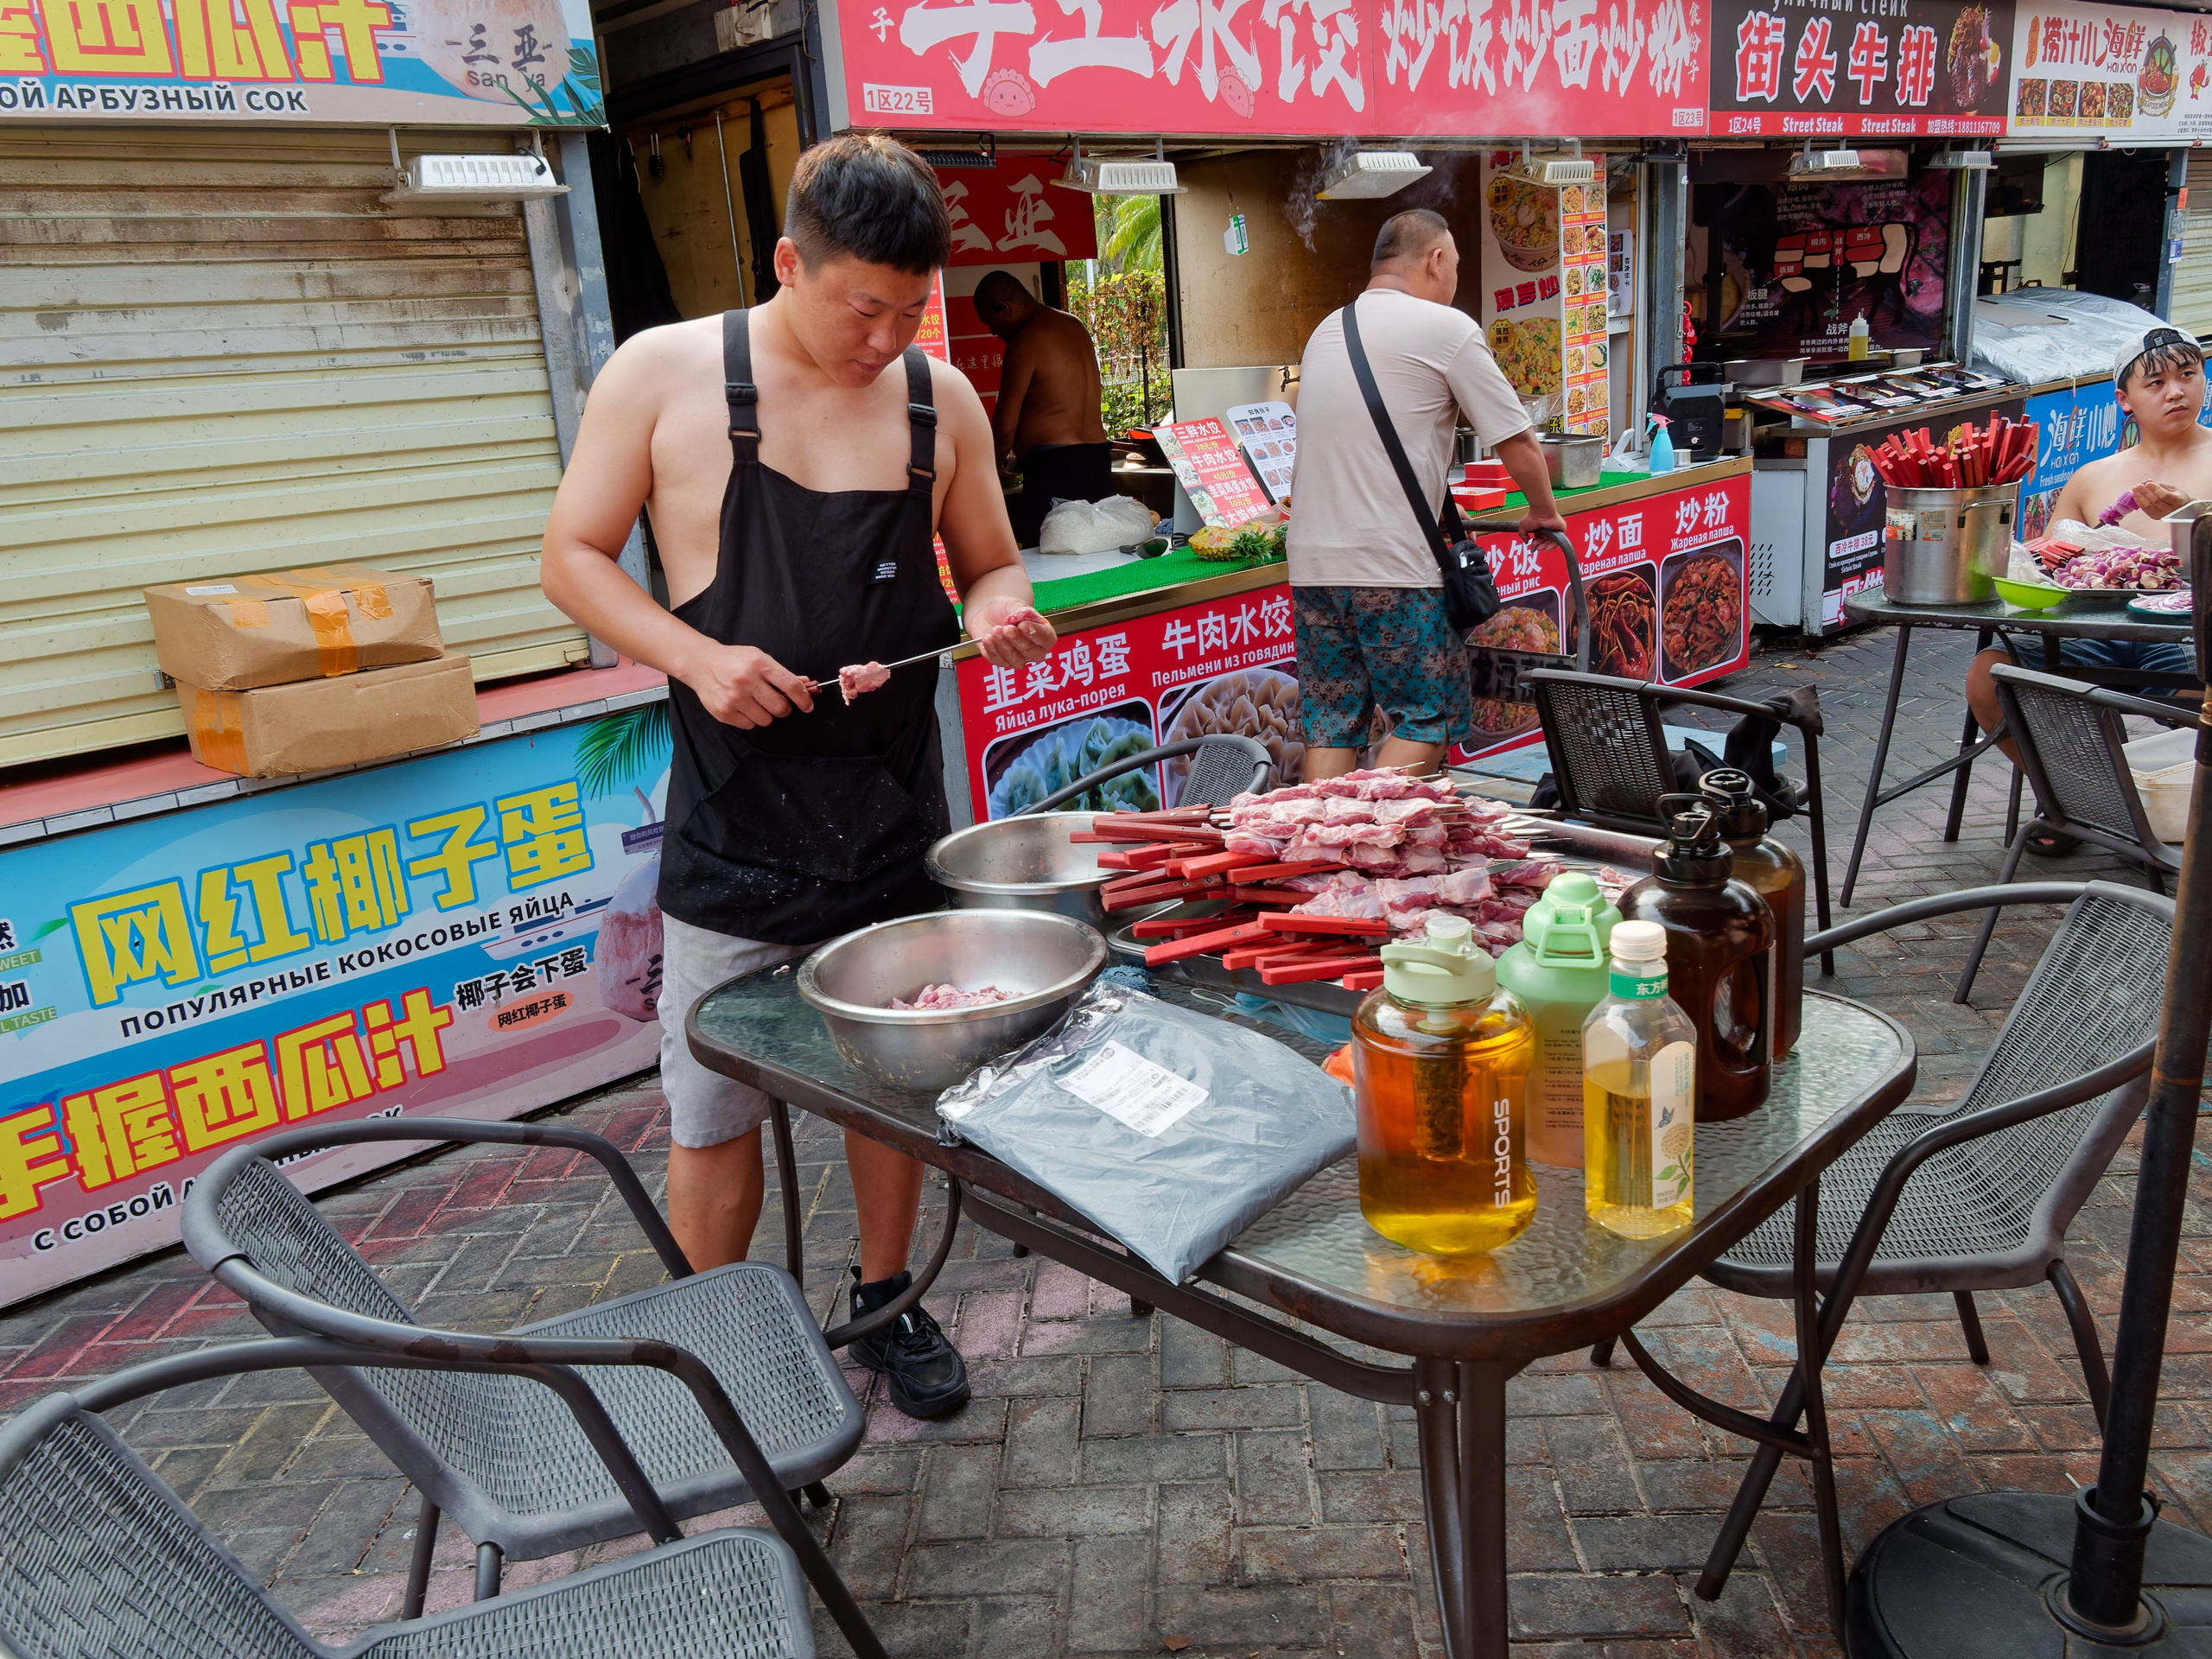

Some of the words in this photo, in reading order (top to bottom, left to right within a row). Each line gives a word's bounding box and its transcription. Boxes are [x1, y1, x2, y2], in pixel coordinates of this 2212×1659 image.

[461, 23, 546, 68] 三亚
[2041, 16, 2147, 68] 捞汁小海鲜
[2190, 19, 2212, 57] 椒
[1736, 10, 1937, 105] 街头牛排
[467, 71, 509, 87] san
[57, 83, 237, 111] АРБУЗНЫЙ
[246, 91, 308, 112] СОК
[866, 90, 932, 113] 1区22号
[1674, 111, 1703, 125] 1区23号
[1728, 118, 1761, 133] 1区24号
[1783, 117, 1814, 133] Street
[1815, 118, 1843, 133] Steak
[1861, 118, 1891, 133] Street
[1891, 118, 1916, 134] Steak
[1826, 323, 1848, 336] 战斧
[1174, 421, 1222, 440] 三鲜水饺
[2040, 401, 2117, 467] 海鲜小炒
[1191, 448, 1239, 468] 牛肉水饺
[1195, 441, 1218, 451] 38元/份
[1213, 469, 1236, 480] 45元/份
[2040, 475, 2053, 487] Fresh
[1208, 477, 1257, 498] 韭菜鸡蛋水饺
[1229, 497, 1252, 508] 30元/份
[1675, 491, 1730, 536] 炒粉
[1585, 512, 1643, 558] 炒面
[1671, 531, 1707, 552] Жареная
[1708, 524, 1734, 543] лапша
[1835, 537, 1860, 556] 西冷牛排
[1860, 534, 1874, 547] 38元
[1618, 548, 1646, 566] лапша
[1496, 577, 1521, 596] еный
[1522, 576, 1541, 594] рис
[1162, 594, 1293, 660] 牛肉水饺
[983, 632, 1131, 714] 韭菜鸡蛋
[1152, 659, 1222, 688] Пельмени
[1224, 654, 1240, 670] из
[1243, 640, 1294, 667] говядин
[995, 706, 1036, 733] Яйца
[1039, 682, 1126, 721] лука-порея
[71, 781, 593, 1006] 网红椰子蛋
[0, 950, 36, 971] WEET
[120, 962, 331, 1037] ПОПУЛЯРНЫЕ
[339, 911, 503, 974] КОКОСОВЫЕ
[509, 891, 575, 926] ЯЙЦА
[456, 948, 588, 1011] 椰子会下蛋
[10, 1007, 58, 1028] TASTE
[497, 994, 568, 1028] 网红椰子蛋
[1494, 1097, 1510, 1209] SPORTS
[35, 1226, 56, 1250] С
[61, 1184, 173, 1240] СОБОЙ
